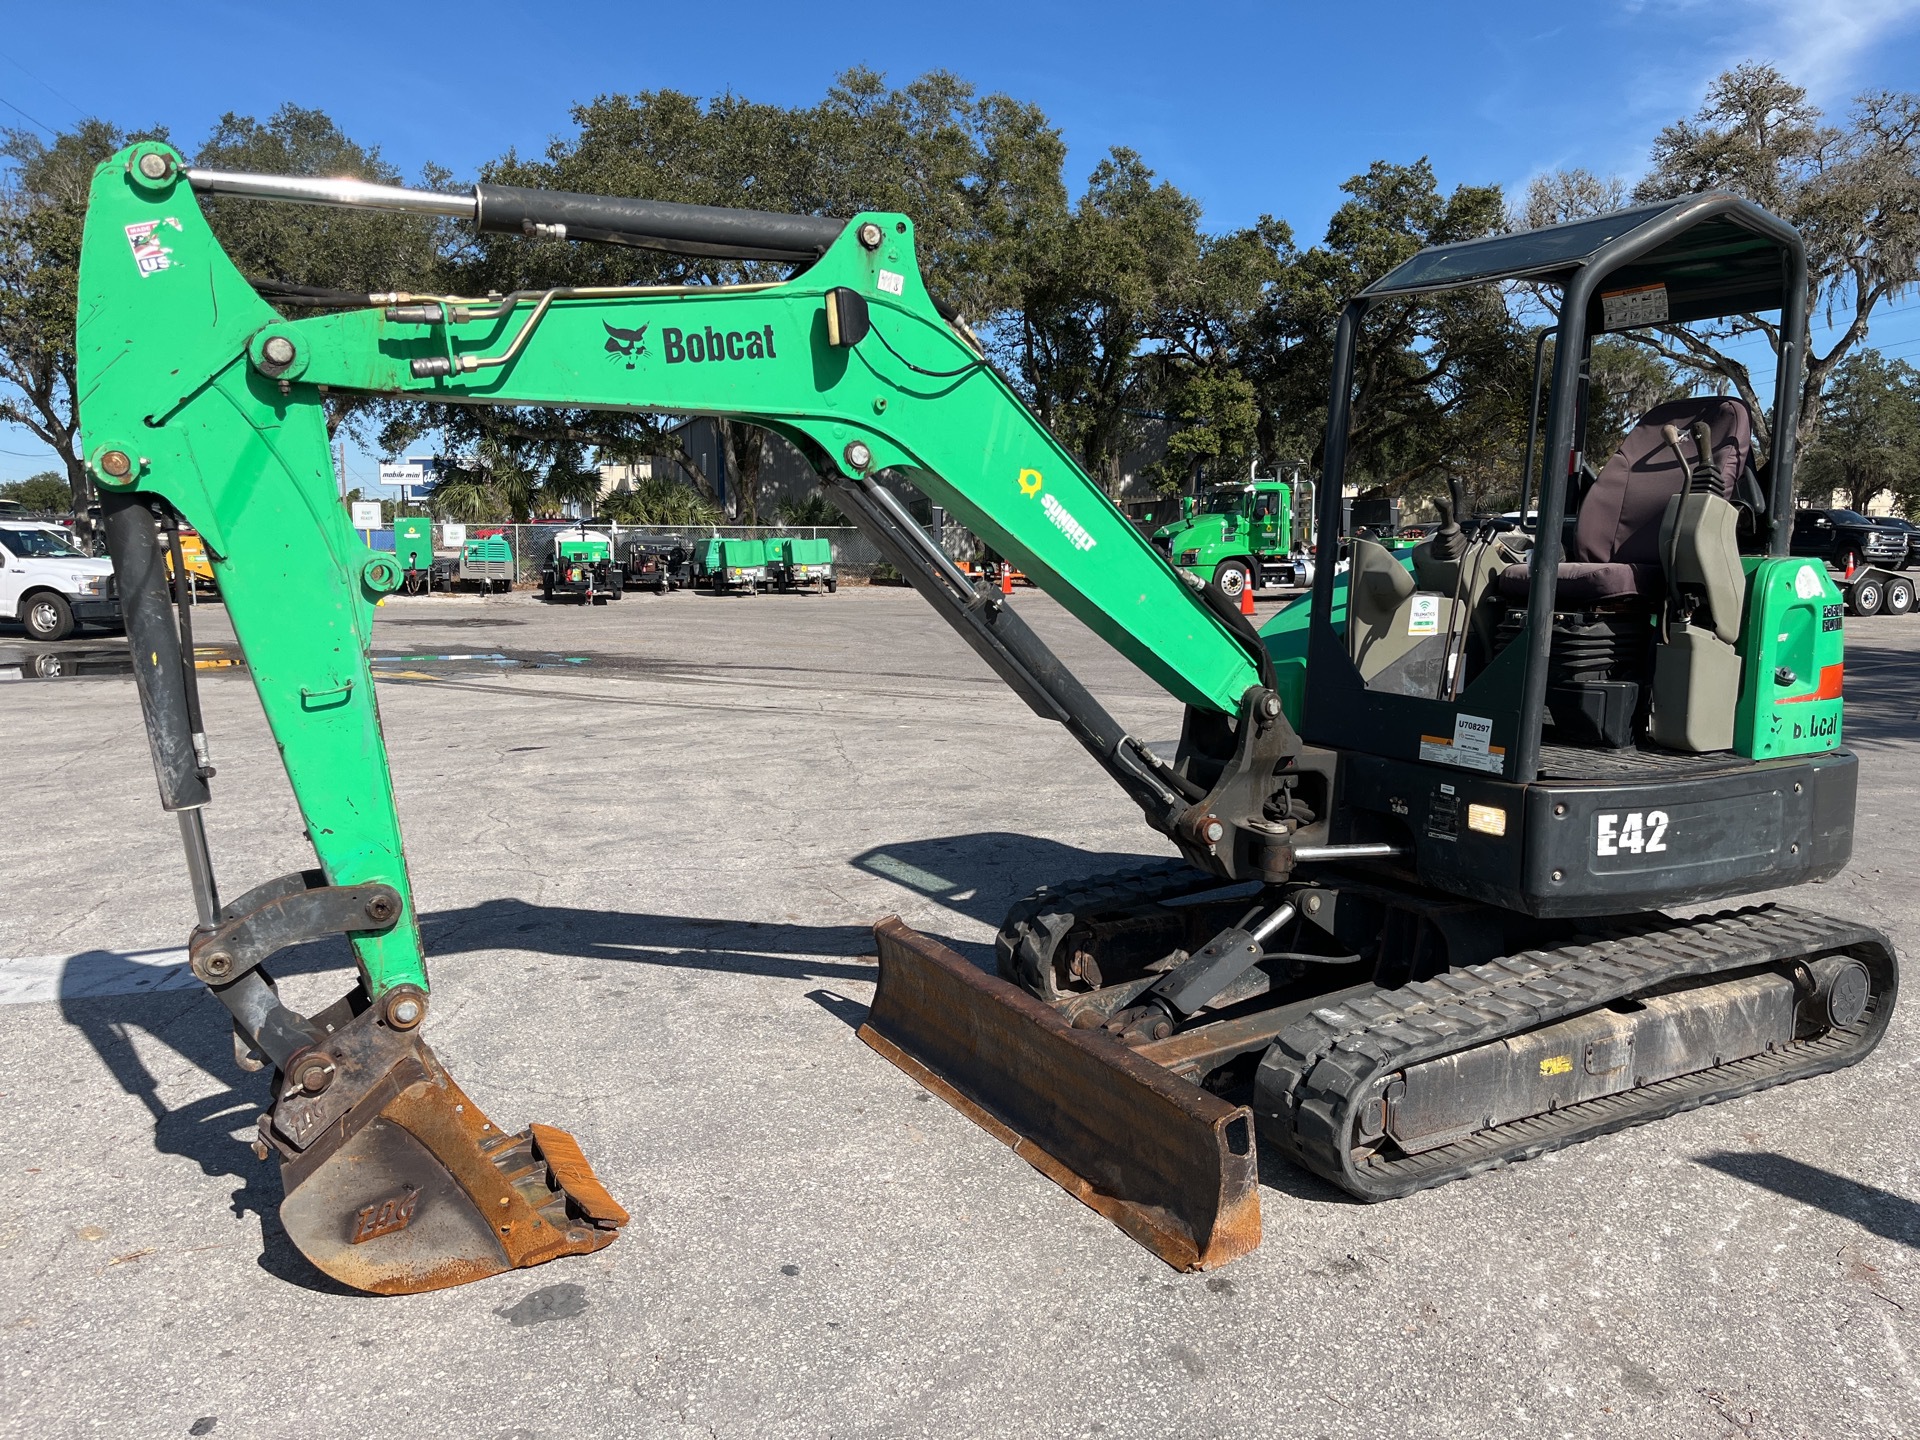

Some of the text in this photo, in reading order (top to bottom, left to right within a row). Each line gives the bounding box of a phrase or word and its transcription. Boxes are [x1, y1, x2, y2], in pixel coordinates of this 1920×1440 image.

[129, 226, 151, 234] MADE
[661, 324, 777, 364] Bobcat
[382, 470, 405, 478] mobile
[1040, 493, 1097, 551] SUNBELT
[1043, 509, 1082, 551] RENTALS
[1458, 720, 1490, 733] U708297
[1597, 810, 1669, 856] E42
